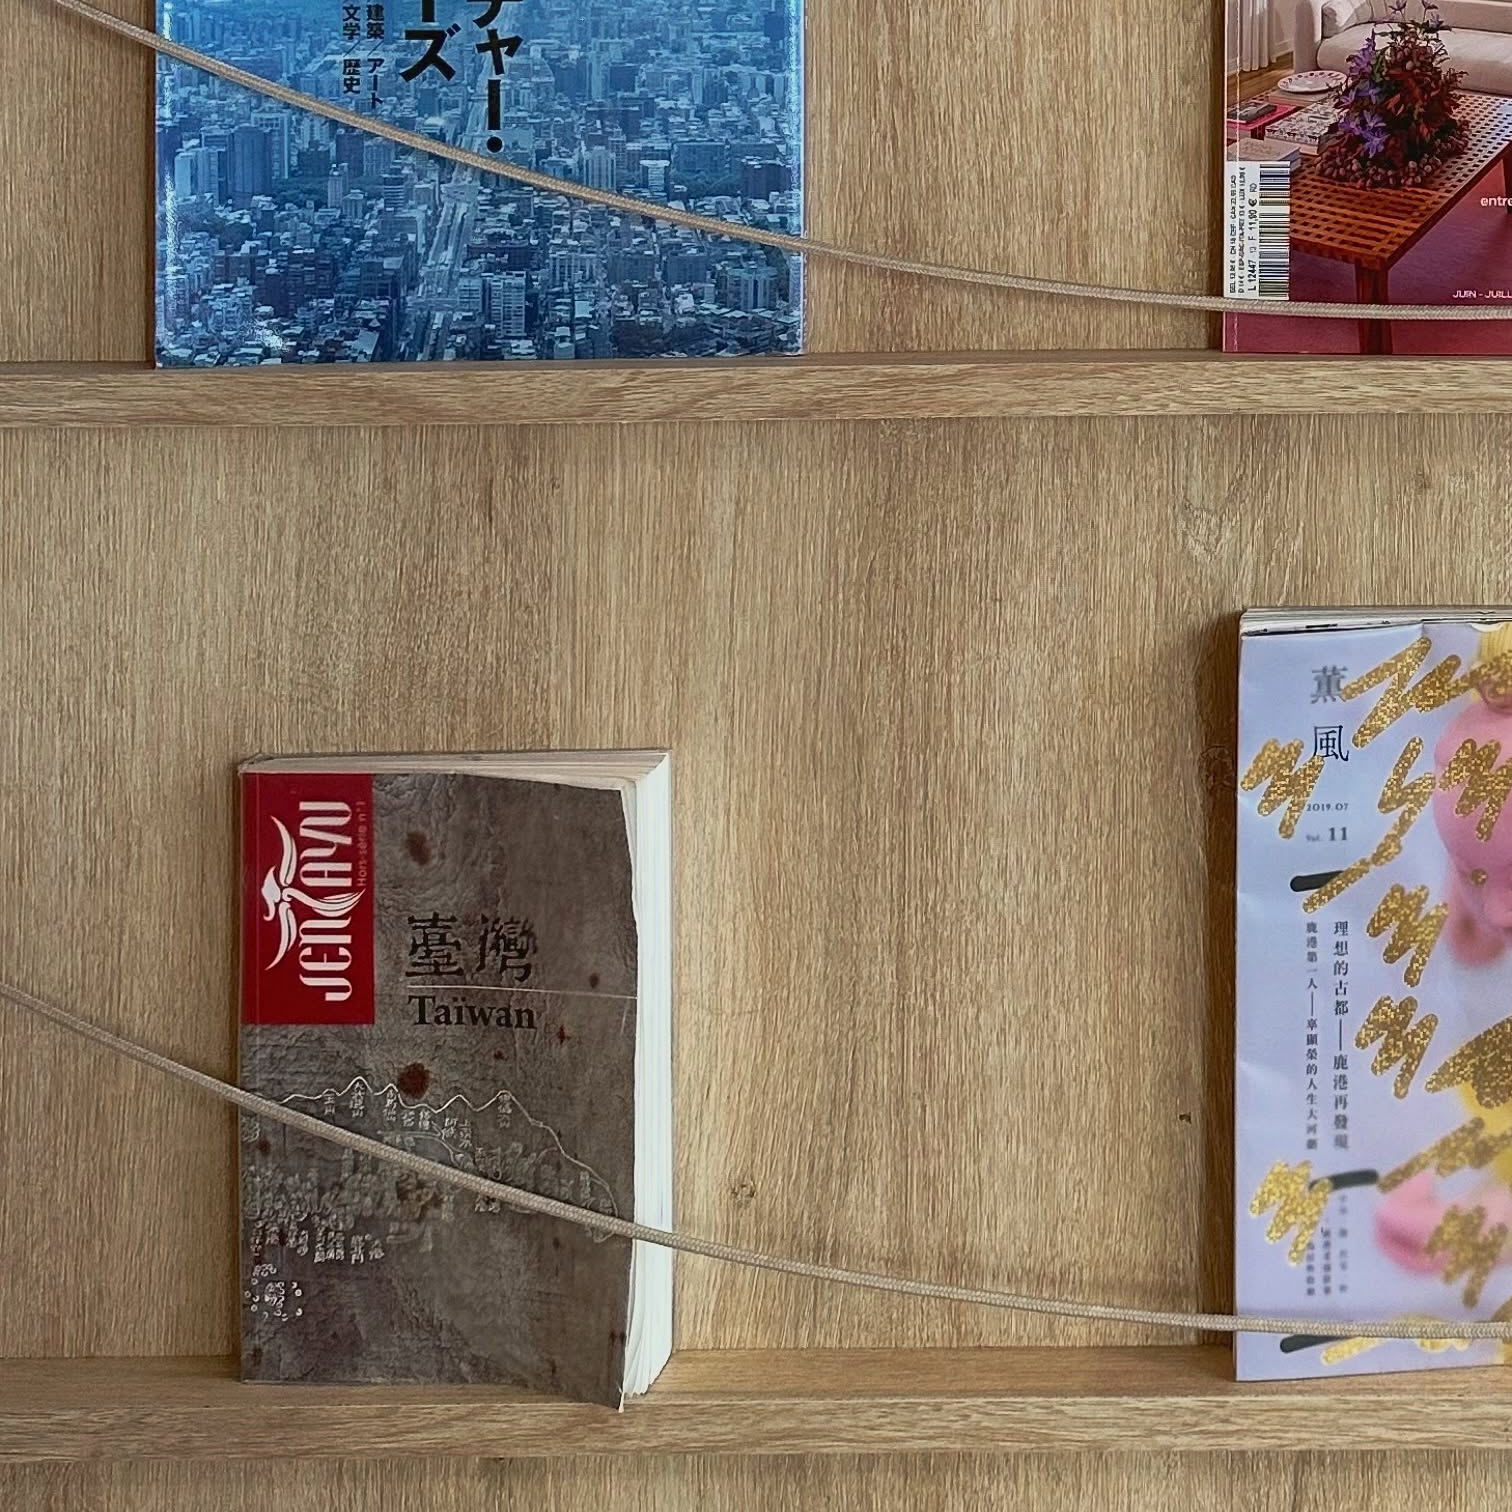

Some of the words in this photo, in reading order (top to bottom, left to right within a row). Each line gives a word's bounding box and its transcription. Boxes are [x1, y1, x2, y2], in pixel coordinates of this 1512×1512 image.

[1453, 290, 1477, 299] JUIN
[1329, 827, 1347, 841] 11
[405, 912, 537, 982] 臺灣
[407, 995, 538, 1031] Taïwan
